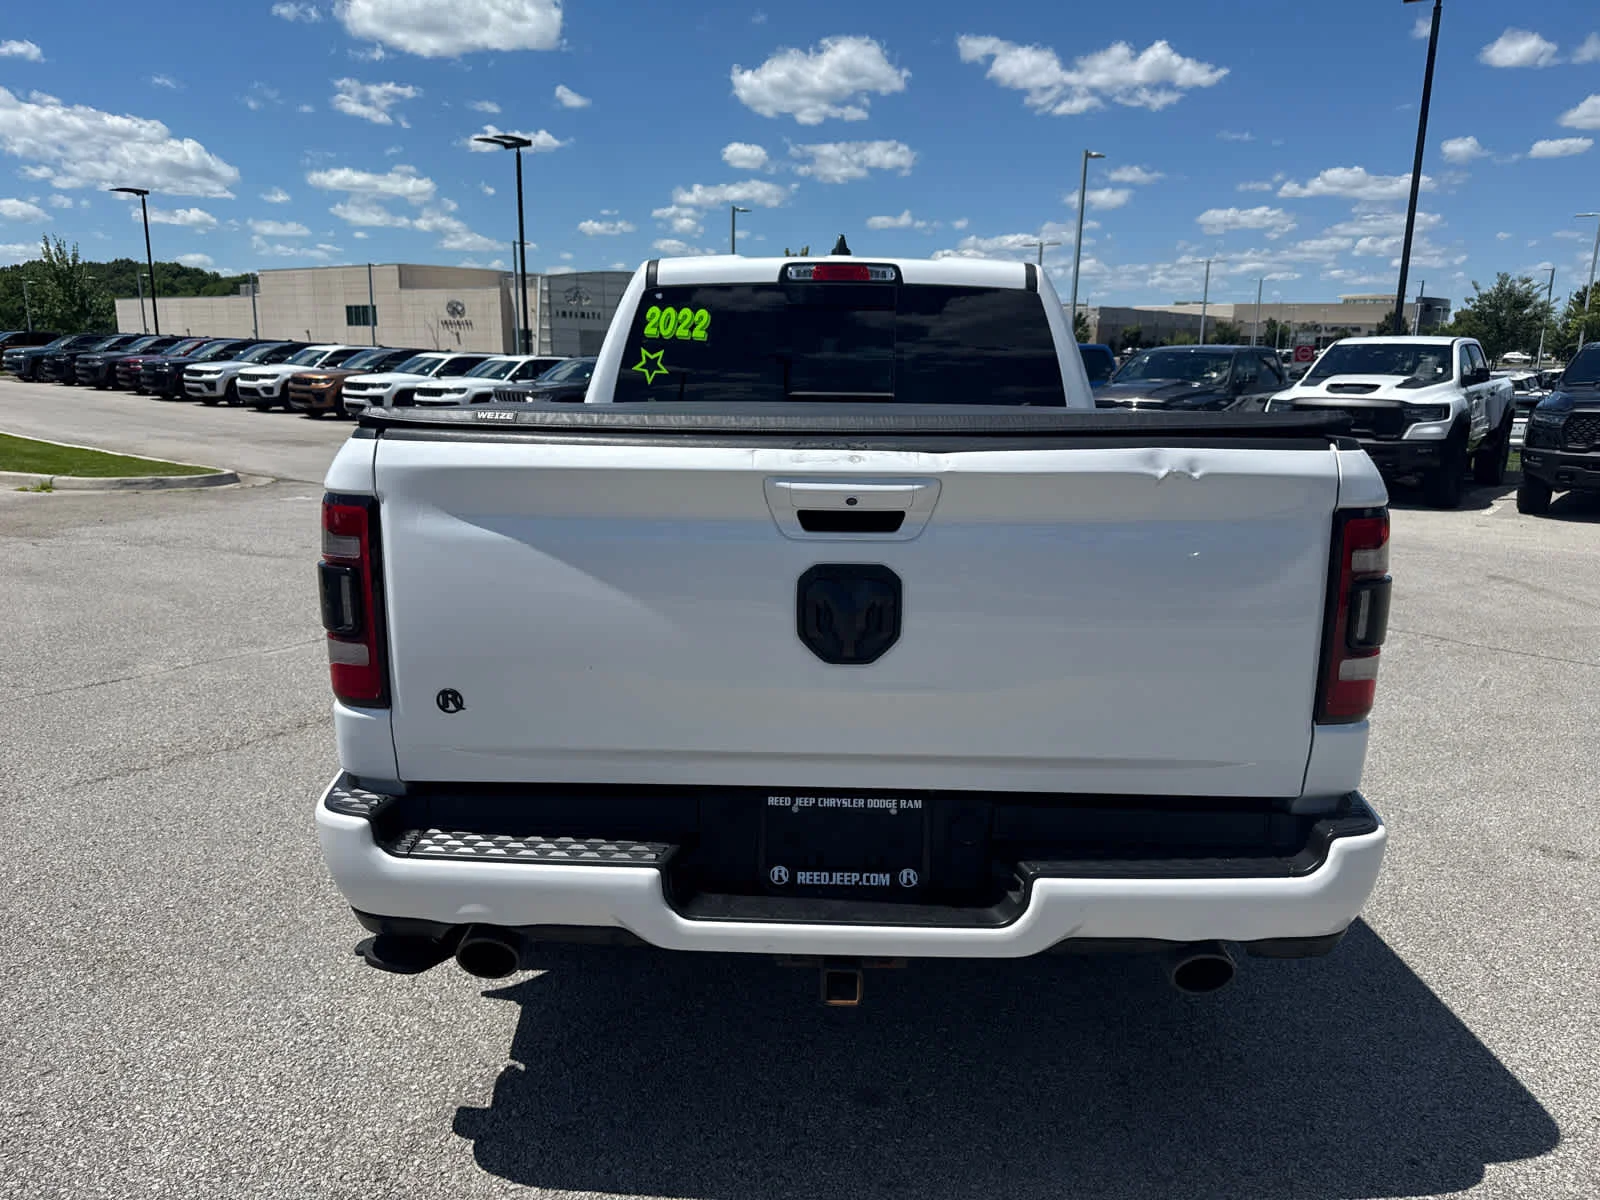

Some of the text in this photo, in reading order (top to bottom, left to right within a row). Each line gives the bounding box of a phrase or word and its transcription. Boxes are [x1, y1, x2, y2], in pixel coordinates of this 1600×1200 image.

[644, 305, 711, 341] 2022
[477, 411, 514, 420] WEIZE
[767, 796, 922, 809] REED JEEP CHRYSLER DODGE RAM
[797, 871, 890, 886] REEDJEEP.COM
